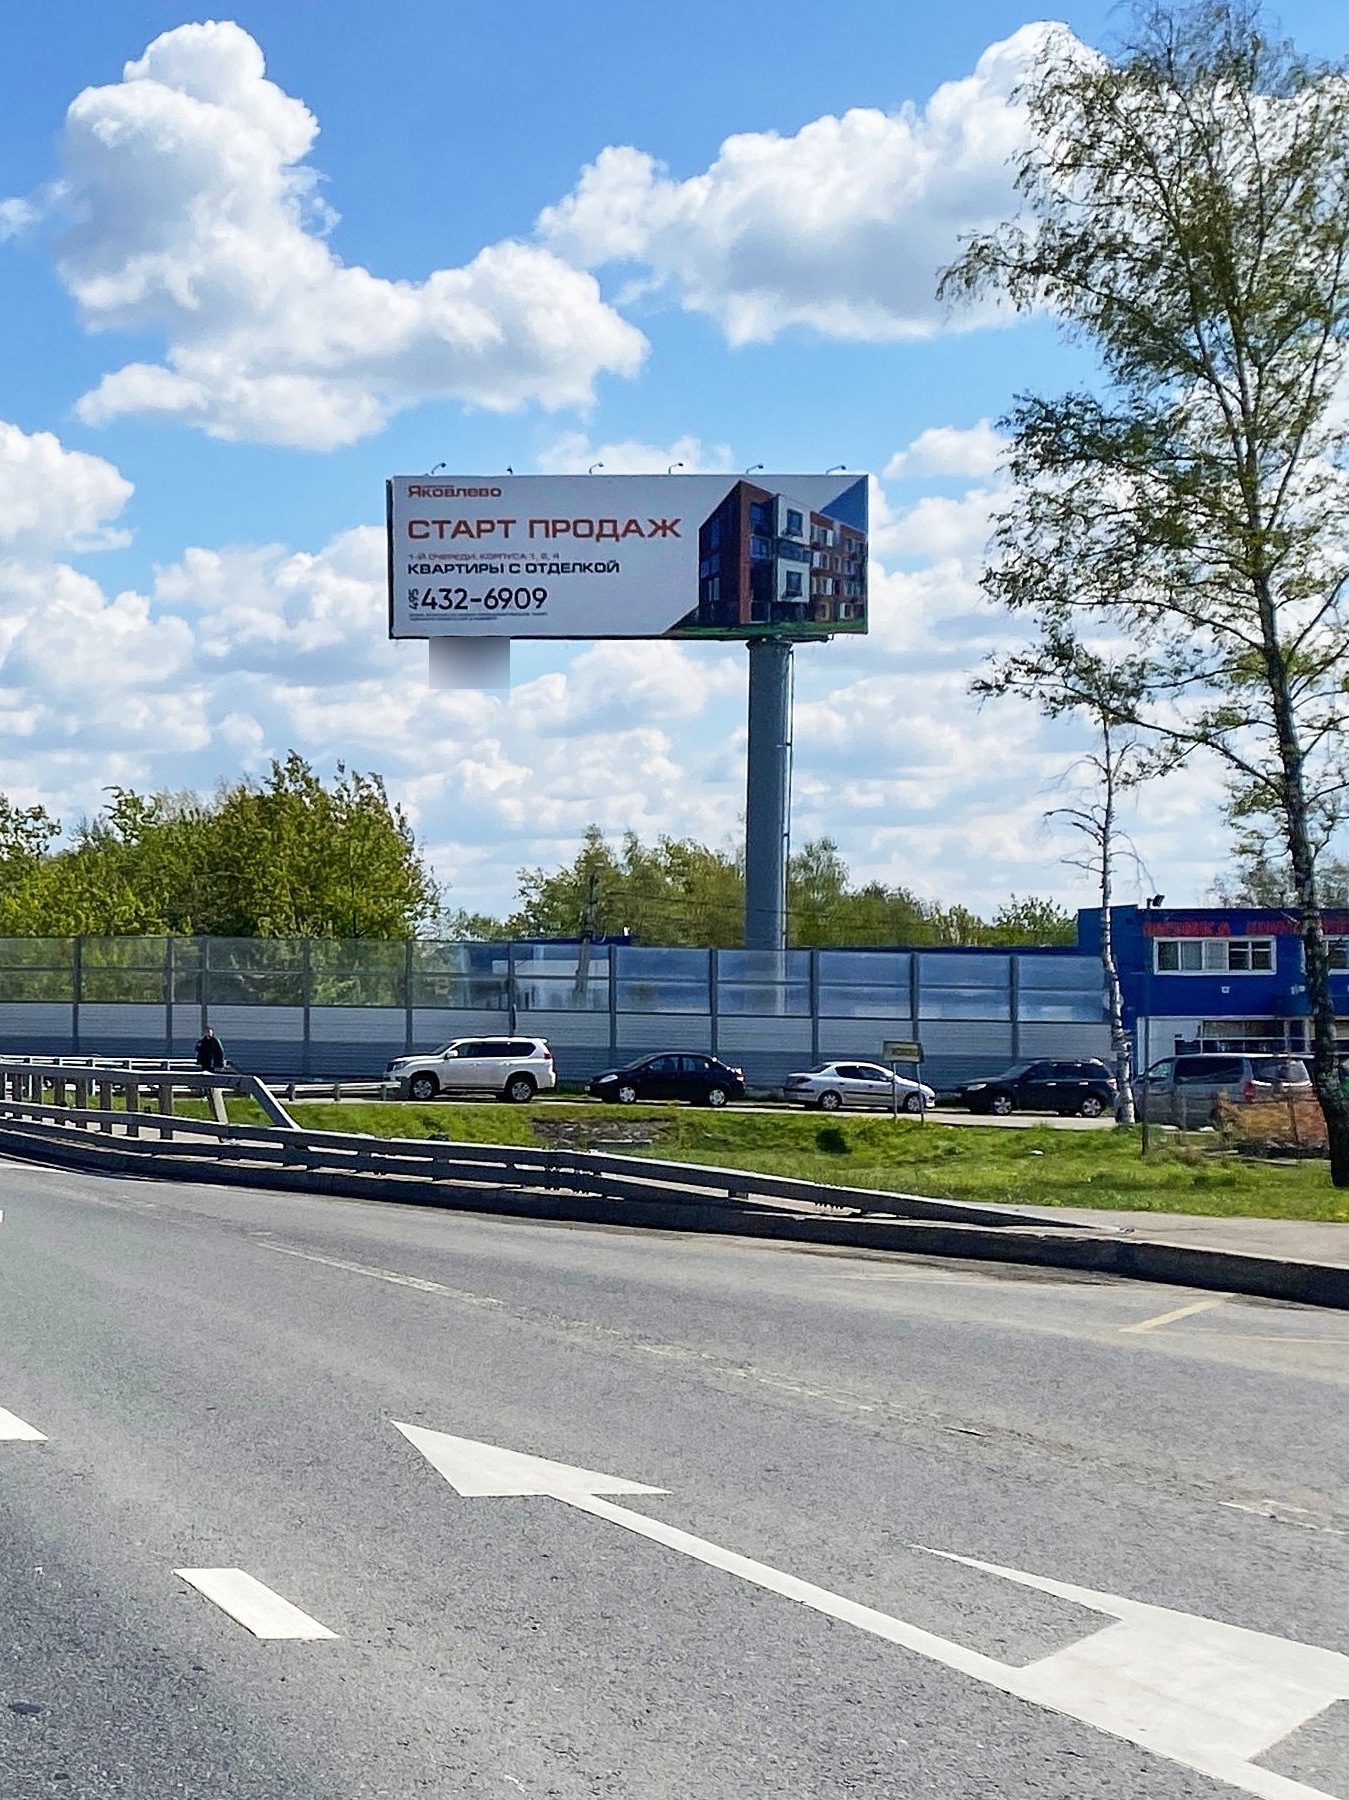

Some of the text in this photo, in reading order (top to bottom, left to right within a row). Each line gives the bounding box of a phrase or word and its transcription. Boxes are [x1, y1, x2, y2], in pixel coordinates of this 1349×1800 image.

[408, 485, 502, 498] Яковлево
[407, 518, 681, 543] СТАРТ ПРОДАЖ
[407, 560, 620, 575] КВАРТИРЫ С ОТДЕЛКОЙ
[408, 587, 548, 611] 495 432-6909
